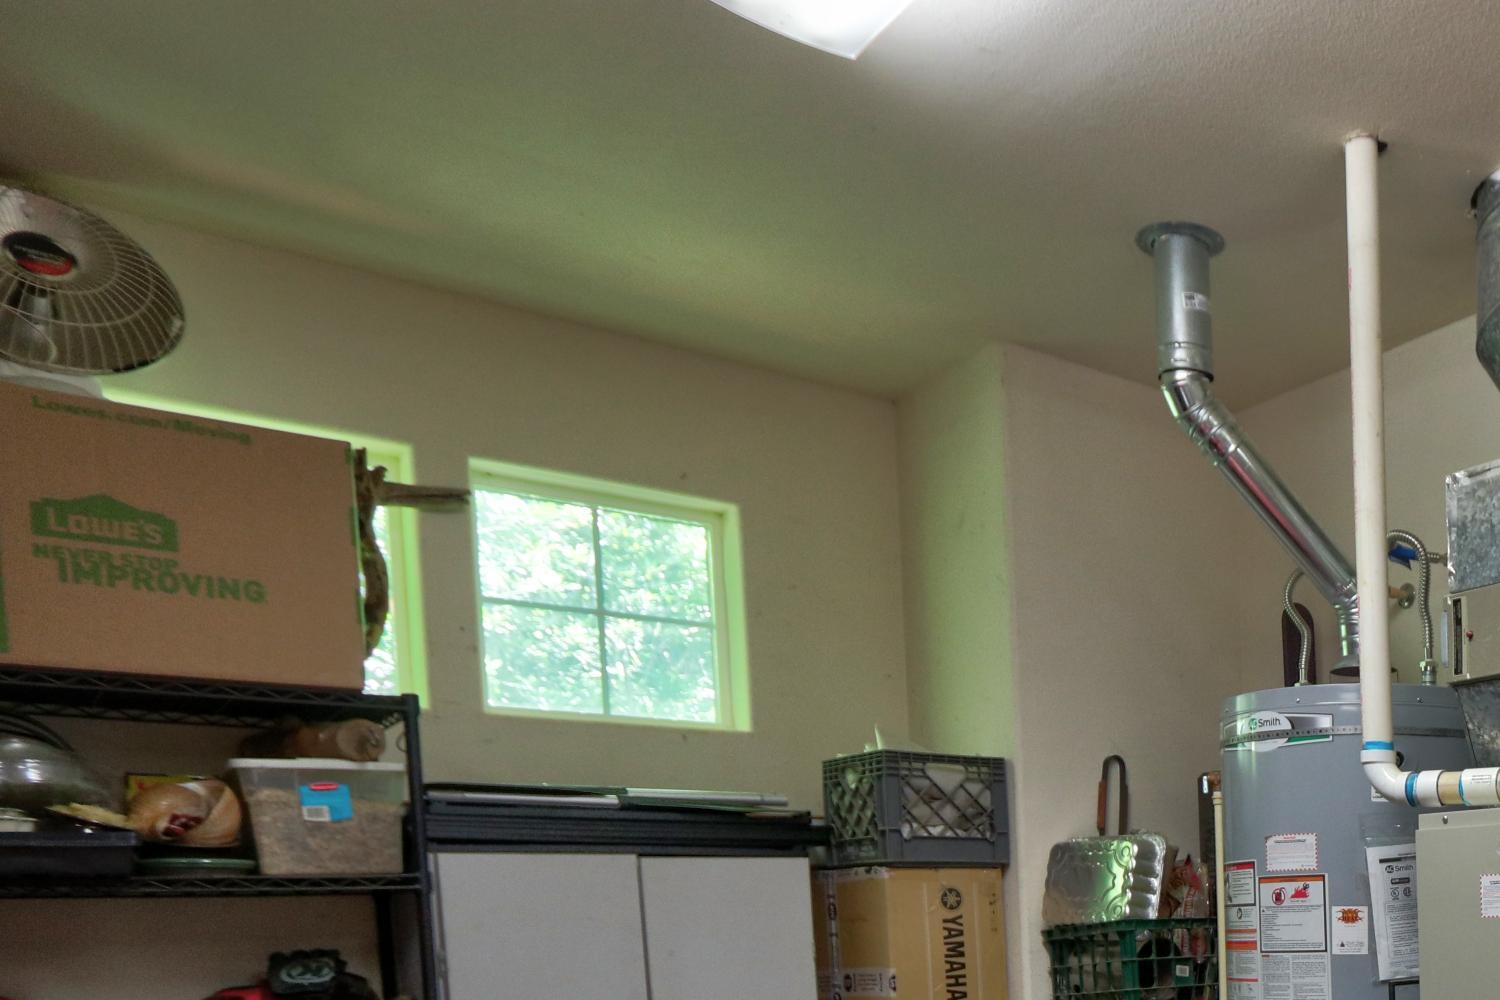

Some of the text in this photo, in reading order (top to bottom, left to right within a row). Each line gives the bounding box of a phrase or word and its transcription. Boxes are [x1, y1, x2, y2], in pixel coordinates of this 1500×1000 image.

[54, 555, 267, 603] IMPROVING
[1258, 717, 1280, 728] Smith
[1394, 864, 1414, 873] Smith
